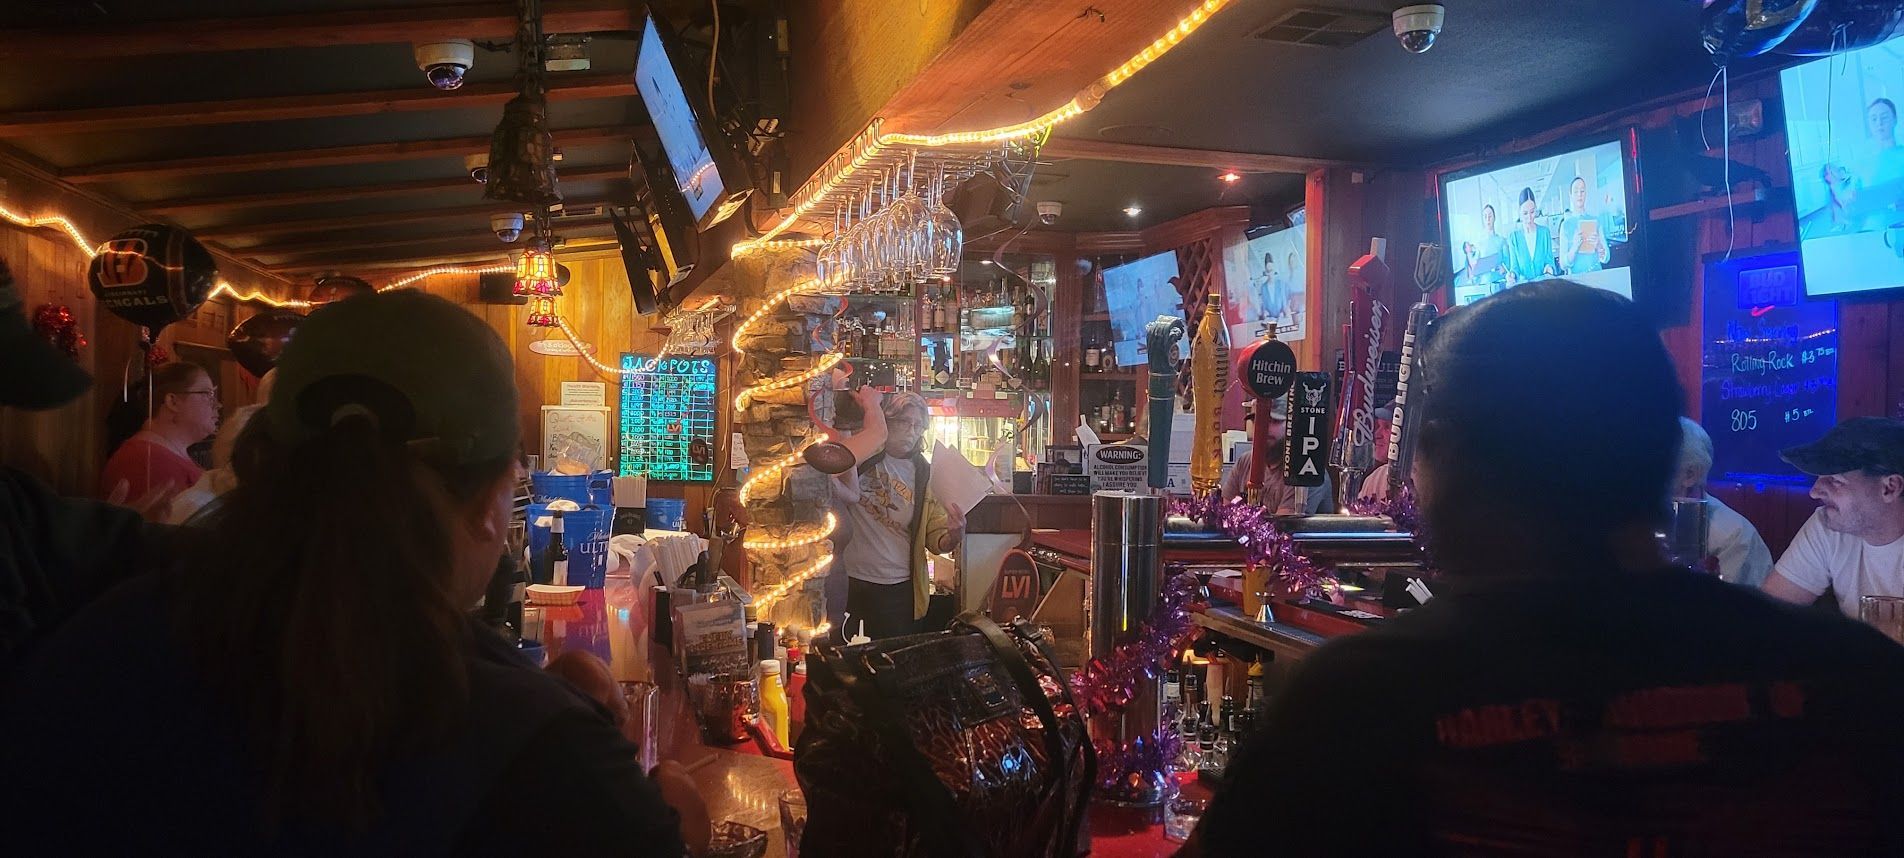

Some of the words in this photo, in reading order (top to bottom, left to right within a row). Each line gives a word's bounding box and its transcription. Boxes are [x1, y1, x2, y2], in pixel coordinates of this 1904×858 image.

[622, 356, 711, 374] JACKPOTS
[1252, 359, 1291, 374] Hitchin
[1352, 300, 1384, 447] Budweiser
[1395, 329, 1416, 405] LIGHT
[1731, 353, 1766, 376] Rolling
[1767, 350, 1794, 371] Rock
[1256, 373, 1284, 385] Brew
[1731, 408, 1757, 432] 805
[1388, 406, 1404, 461] BUD
[1100, 449, 1141, 460] WARNING:
[1284, 439, 1292, 478] STONE
[1298, 417, 1320, 476] IPA
[1167, 478, 1176, 488] A
[1001, 575, 1031, 599] LVI
